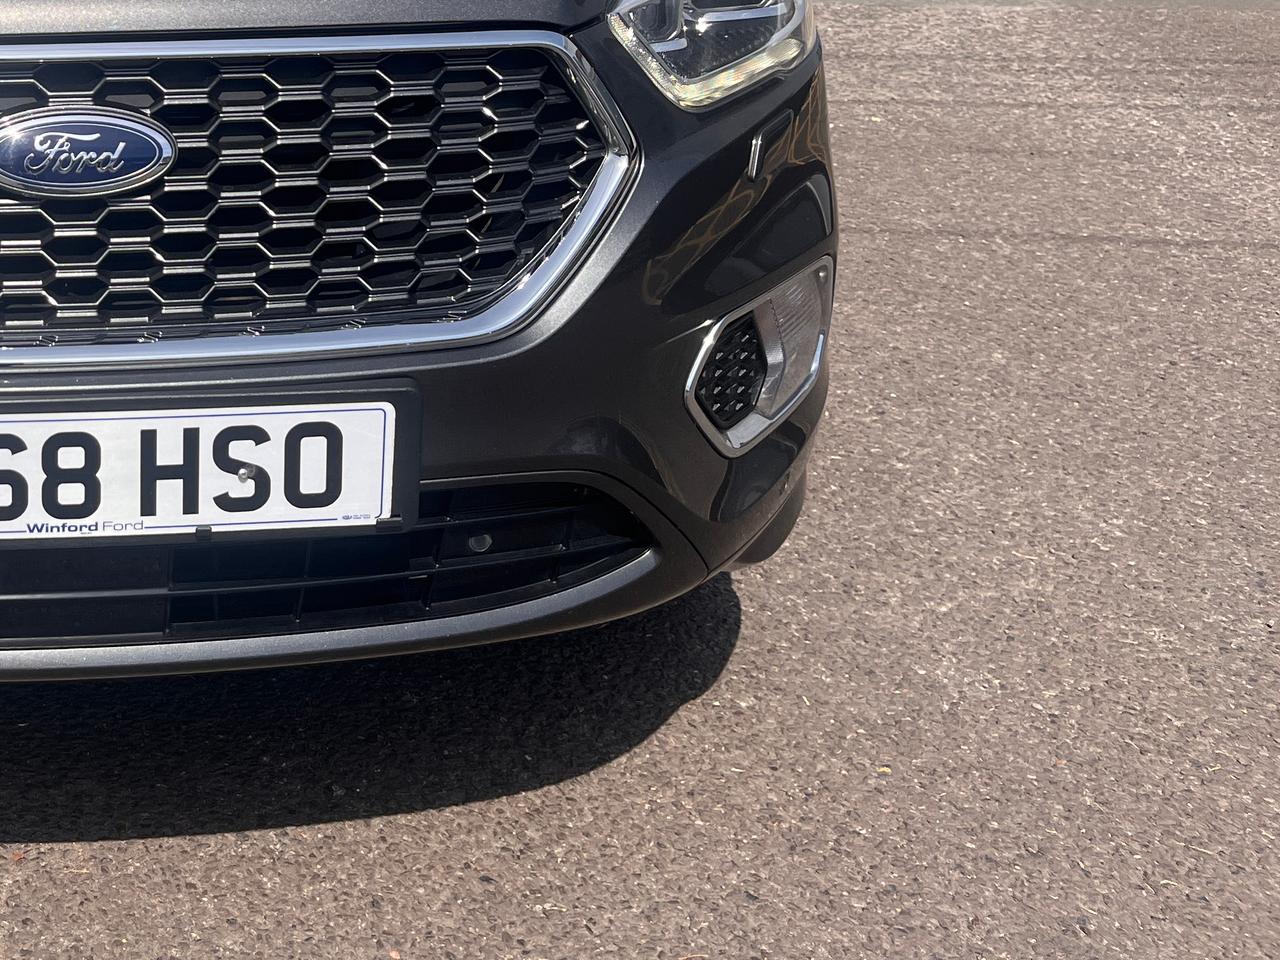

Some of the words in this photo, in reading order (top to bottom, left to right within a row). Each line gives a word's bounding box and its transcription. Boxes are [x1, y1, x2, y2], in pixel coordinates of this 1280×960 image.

[23, 131, 126, 175] Ford
[140, 421, 344, 517] HSO
[26, 522, 99, 534] Winford
[102, 520, 144, 532] Ford
